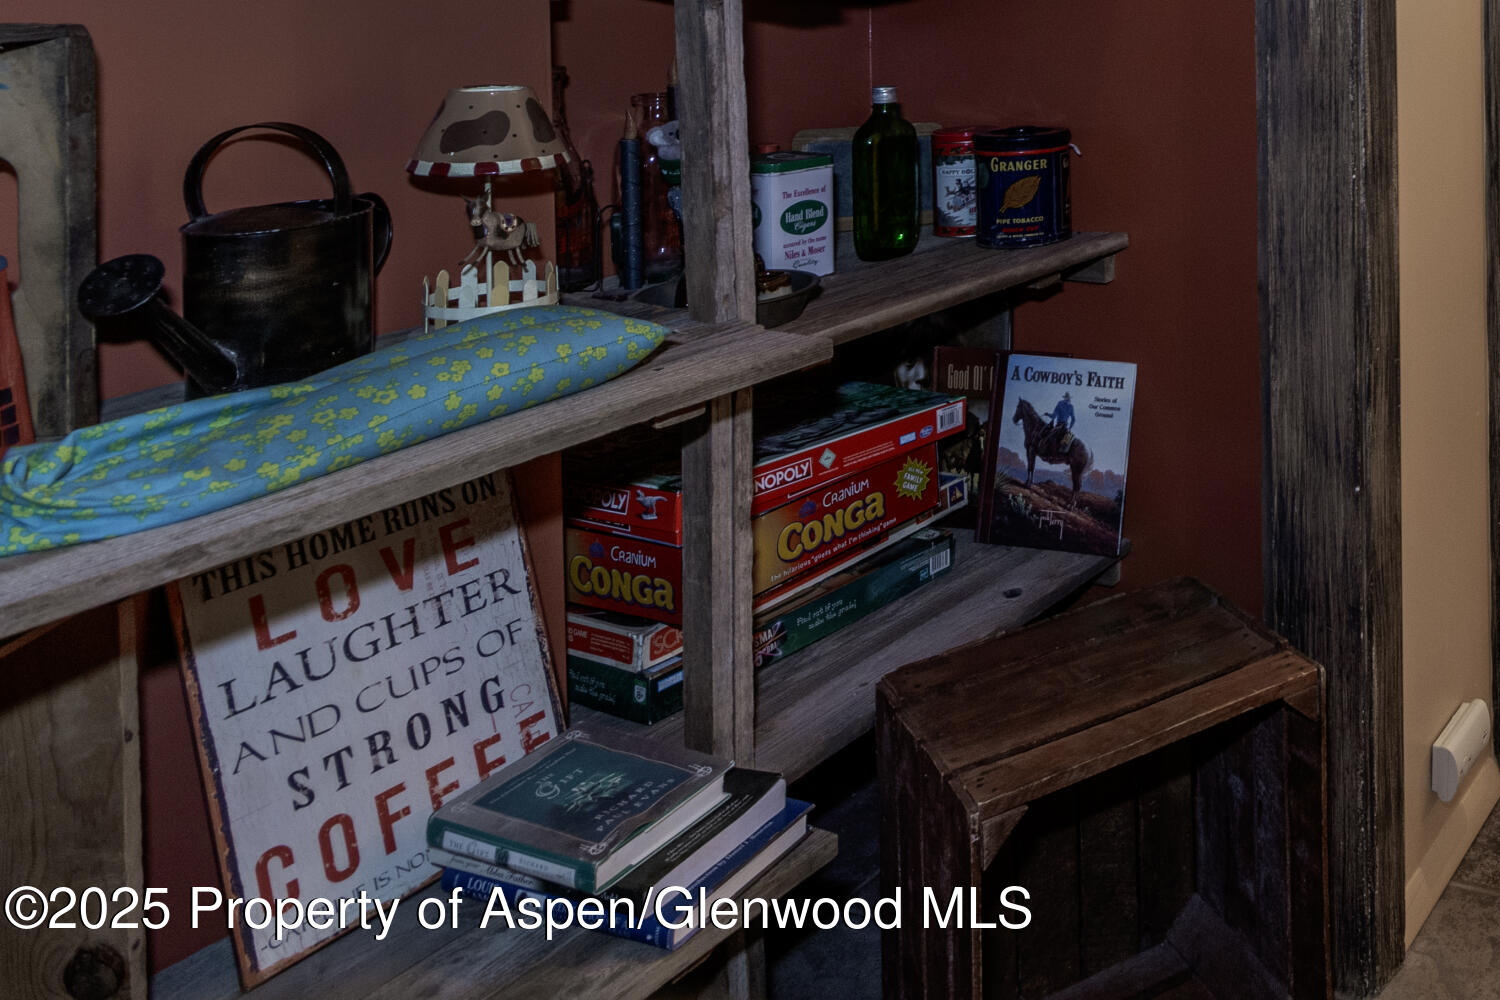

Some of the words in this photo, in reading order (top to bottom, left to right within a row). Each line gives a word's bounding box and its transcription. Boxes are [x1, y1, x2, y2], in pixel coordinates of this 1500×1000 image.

[990, 157, 1048, 172] GRANGER
[782, 190, 792, 199] The
[794, 187, 819, 197] Excellence
[820, 185, 826, 193] of
[785, 210, 803, 223] Hand
[805, 206, 824, 219] Blend
[1012, 216, 1044, 224] TOBACCO
[785, 249, 800, 260] Niles
[808, 245, 826, 256] Moser
[947, 363, 970, 390] Good
[1011, 365, 1020, 381] A
[1024, 366, 1083, 386] COWBOY'S
[1086, 371, 1125, 389] FAITH
[902, 481, 918, 492] GAME
[903, 472, 924, 484] FAMILY
[192, 550, 277, 603] THIS
[285, 516, 377, 570] HOME
[382, 489, 456, 535] RUNS
[461, 473, 498, 506] ON
[833, 541, 848, 552] what
[247, 517, 481, 653] LOVE
[218, 567, 523, 720] LAUGHTER
[231, 701, 343, 775] AND
[355, 646, 466, 714] CUPS
[475, 617, 524, 660] OF
[286, 674, 507, 812] STRONG
[253, 709, 551, 918] COFFEE
